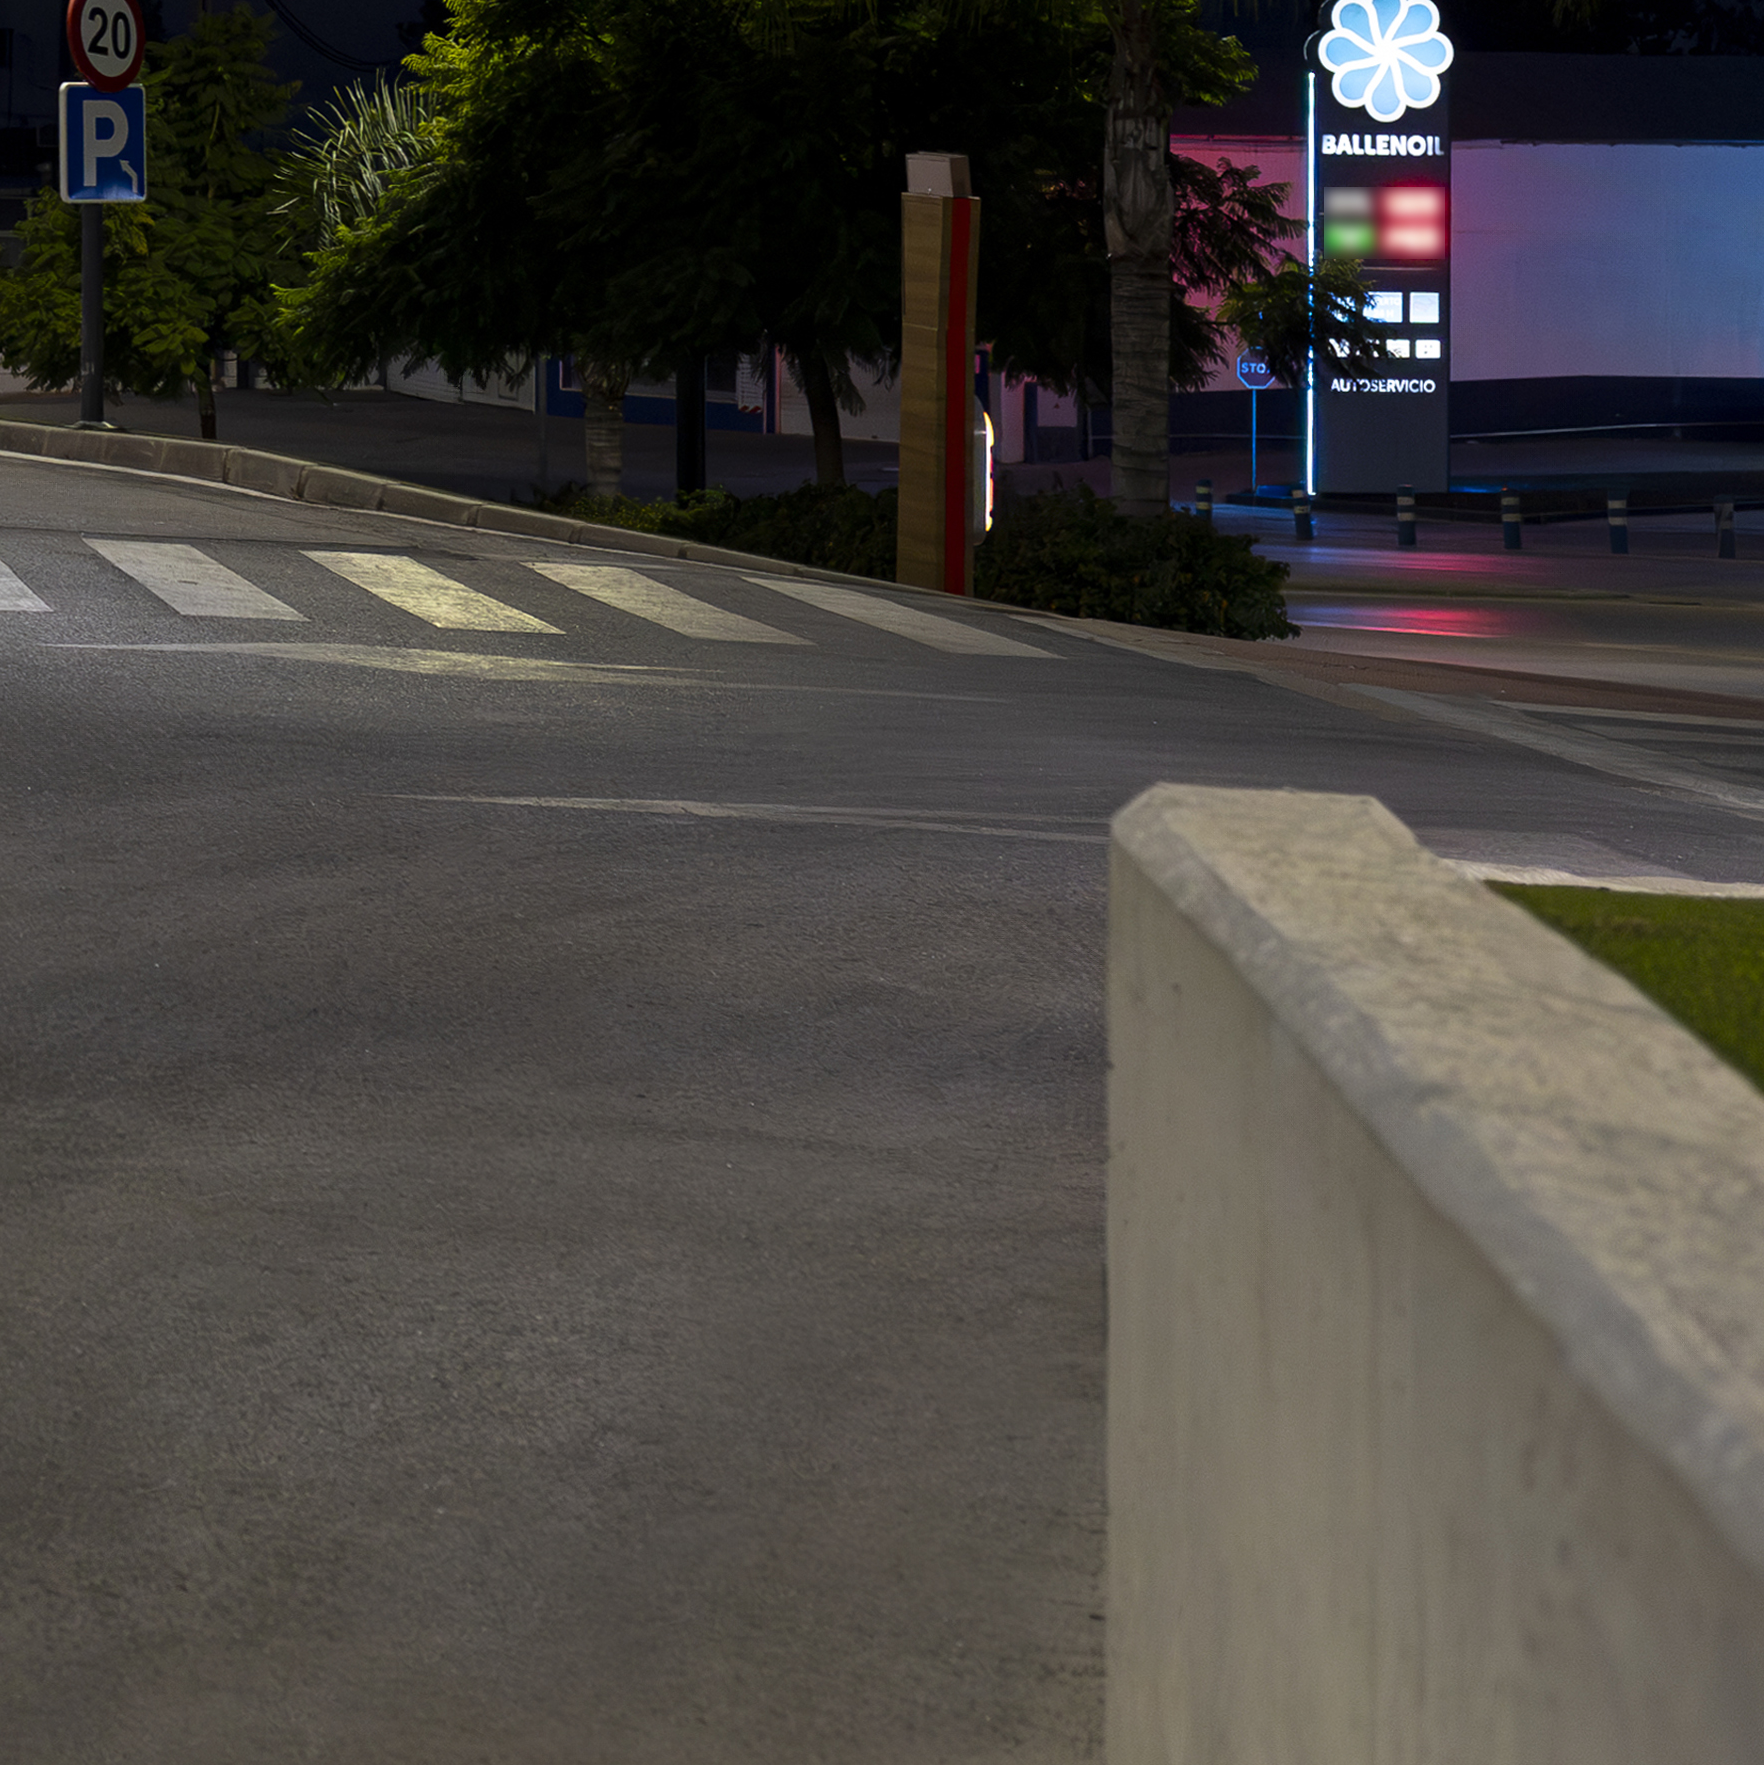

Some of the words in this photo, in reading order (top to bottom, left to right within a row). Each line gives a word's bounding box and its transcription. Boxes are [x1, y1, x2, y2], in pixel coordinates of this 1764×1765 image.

[87, 6, 131, 60] 20
[82, 99, 129, 187] P
[1321, 133, 1445, 157] BALLENOIL
[1241, 361, 1271, 375] STO
[1330, 377, 1437, 394] AUTOSERVICIO
